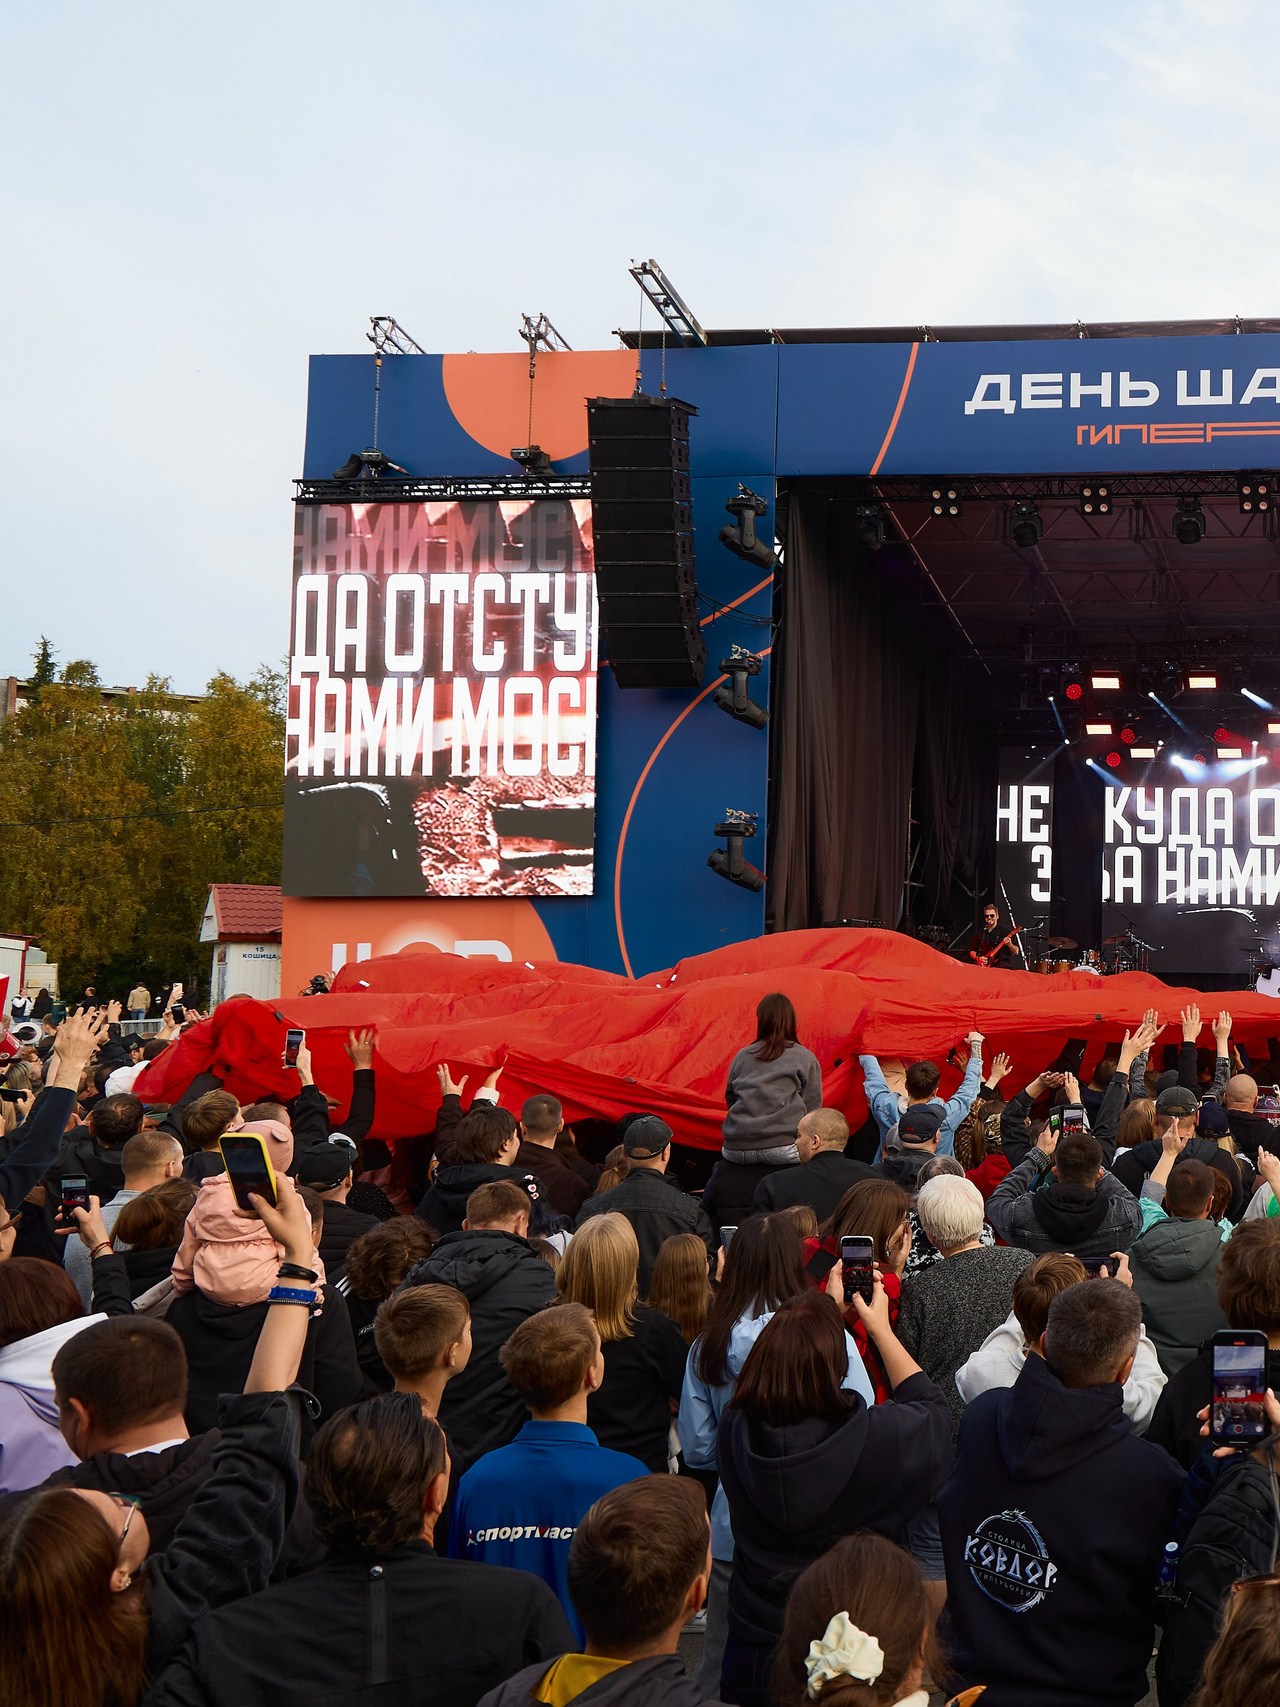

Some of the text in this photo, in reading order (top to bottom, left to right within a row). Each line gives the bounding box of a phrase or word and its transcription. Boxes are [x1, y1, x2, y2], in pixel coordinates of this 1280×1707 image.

[964, 371, 1160, 415] ДЕНЬ
[291, 573, 598, 685] ДА ОТСТУ
[476, 1524, 578, 1542] спортмас
[988, 1531, 1027, 1551] СТОЛИЦА
